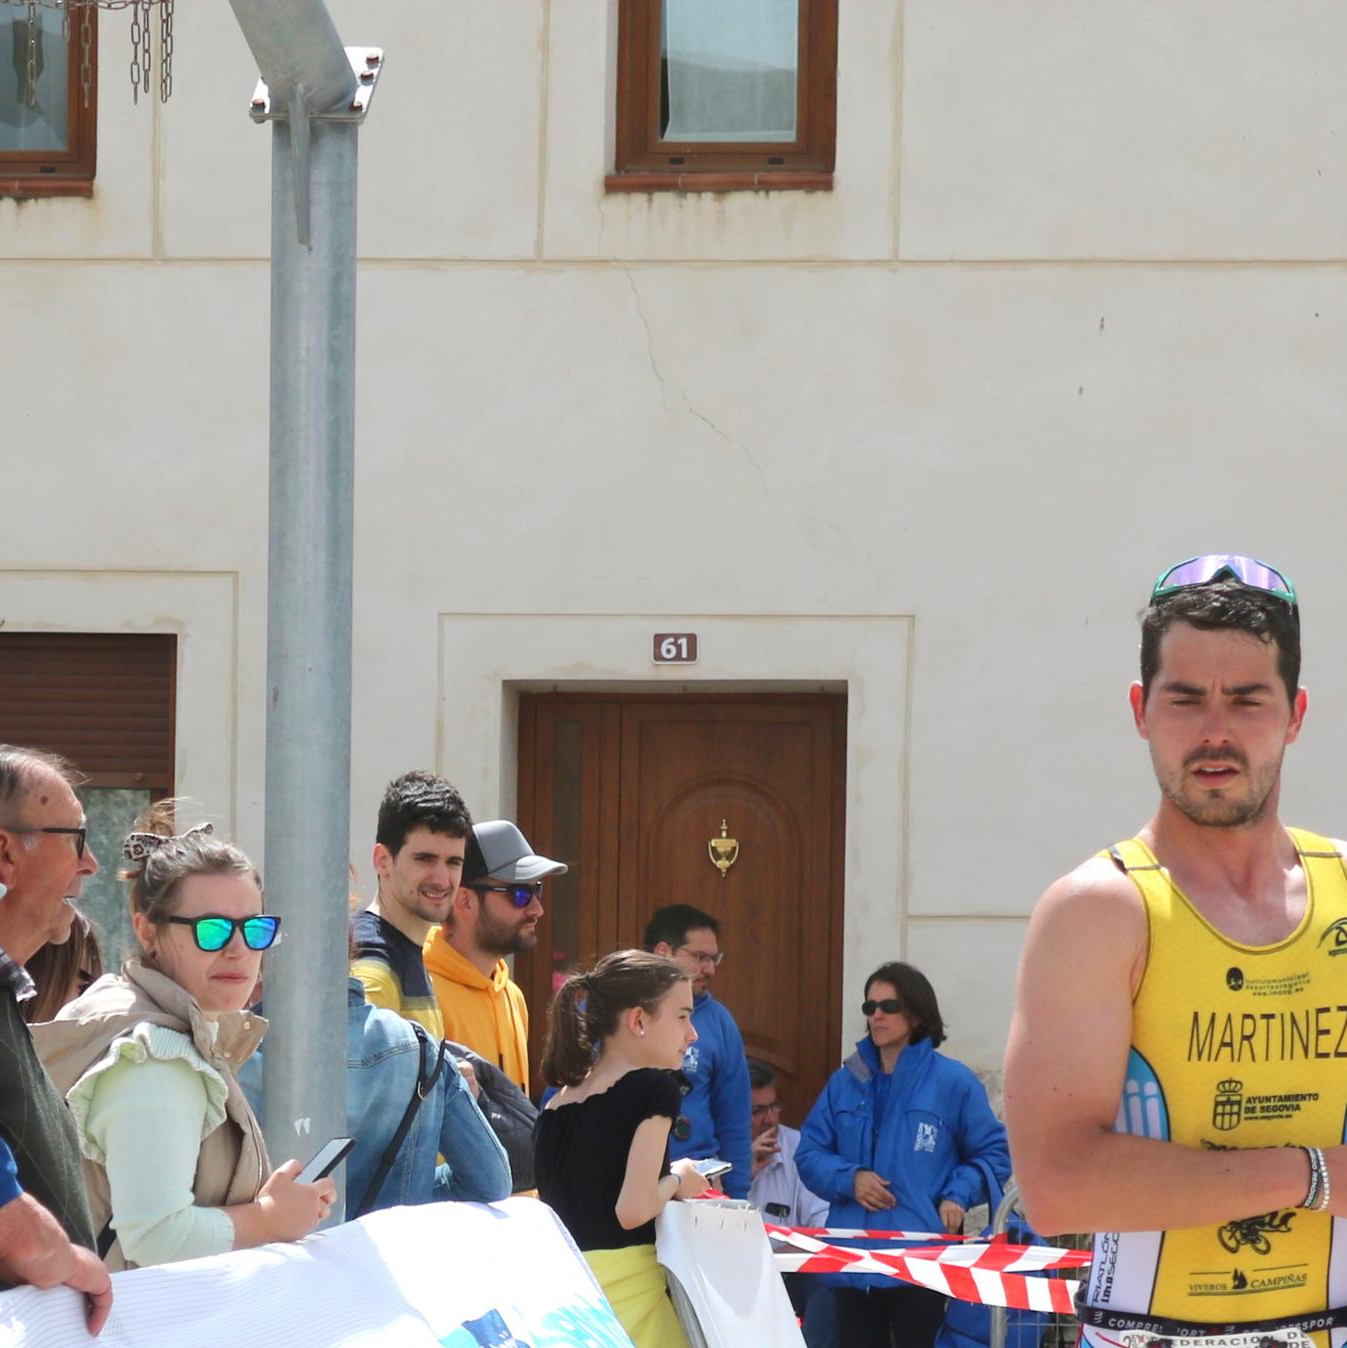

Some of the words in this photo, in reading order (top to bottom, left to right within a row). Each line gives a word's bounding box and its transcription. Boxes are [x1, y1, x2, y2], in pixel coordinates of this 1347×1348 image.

[660, 638, 688, 659] 61
[1246, 1093, 1319, 1104] AYUNTAMIENTO
[1244, 1105, 1257, 1114] DE
[1260, 1104, 1300, 1113] SEGOVIA
[1189, 1283, 1228, 1291] VIVEROS
[1250, 1273, 1308, 1289] CAMPIÑAS
